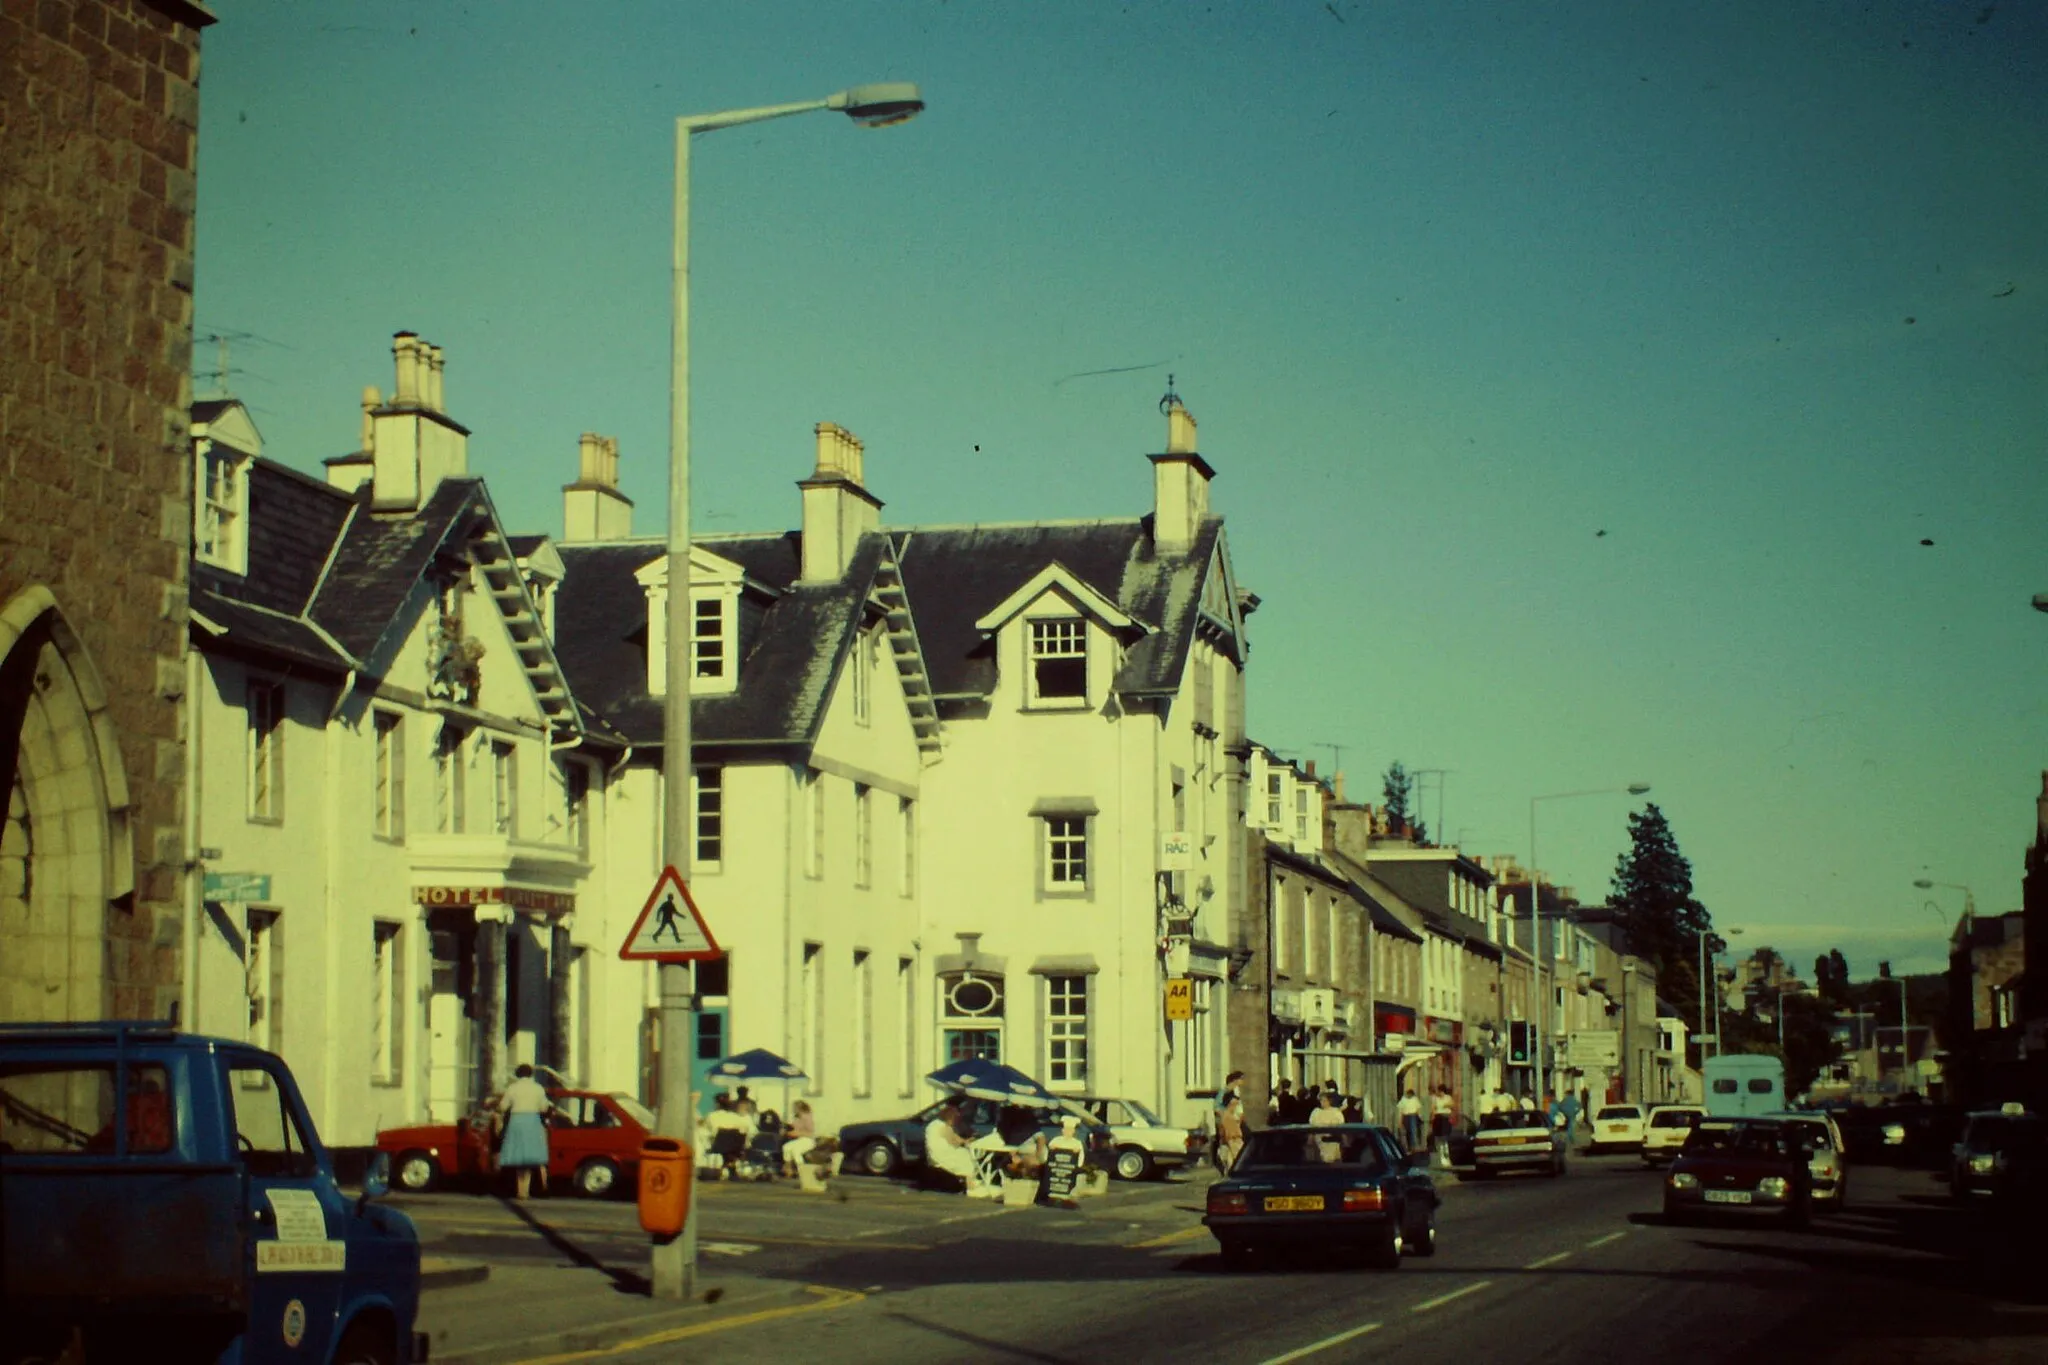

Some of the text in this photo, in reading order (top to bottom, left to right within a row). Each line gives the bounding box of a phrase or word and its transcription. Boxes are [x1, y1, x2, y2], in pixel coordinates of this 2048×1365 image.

[1165, 842, 1189, 854] RAC
[414, 886, 501, 904] HOTEL
[1170, 985, 1188, 997] AA
